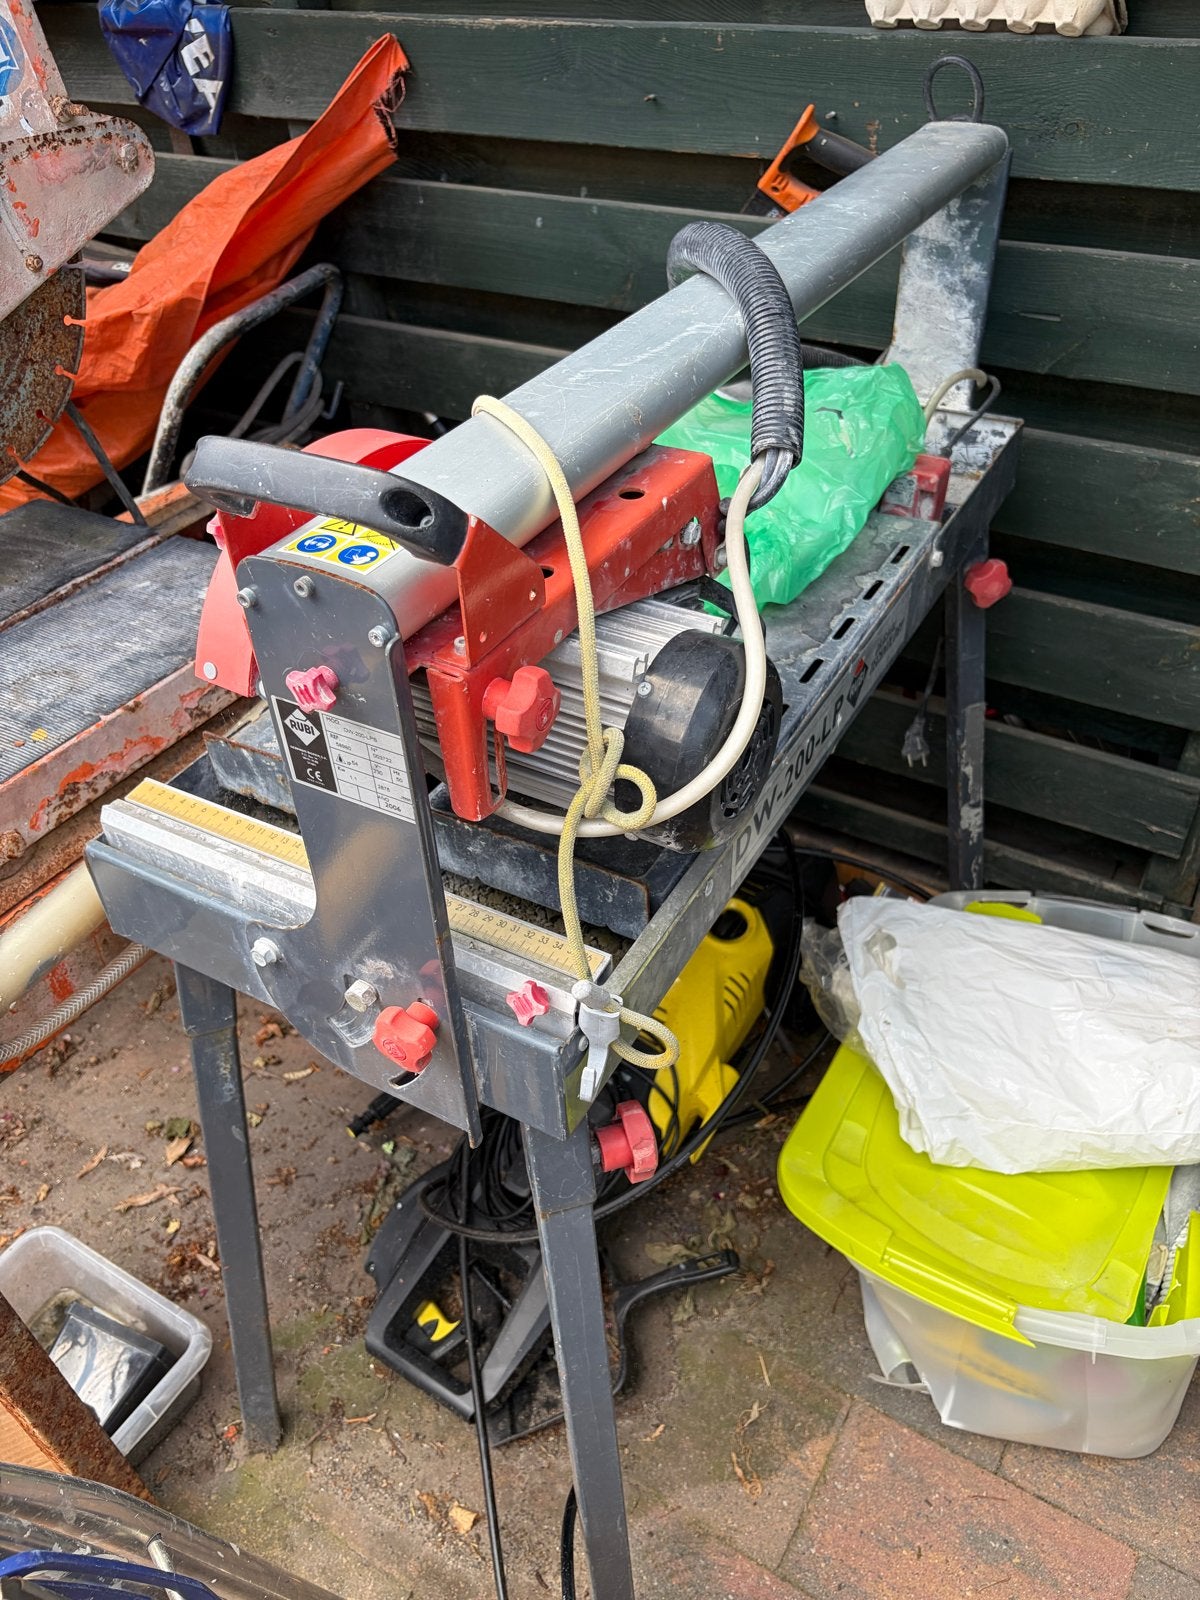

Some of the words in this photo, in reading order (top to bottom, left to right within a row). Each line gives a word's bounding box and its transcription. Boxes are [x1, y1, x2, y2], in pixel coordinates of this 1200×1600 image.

[289, 719, 316, 736] RUBI
[306, 767, 323, 782] CE
[734, 694, 844, 866] DW-200-LP
[384, 801, 402, 813] 2006
[455, 903, 467, 912] 27
[468, 909, 480, 918] 28
[482, 914, 494, 923] 29
[495, 919, 508, 928] 30
[510, 924, 521, 934] 31
[523, 930, 536, 940] 32
[538, 935, 550, 945] 33
[552, 940, 565, 950] 34
